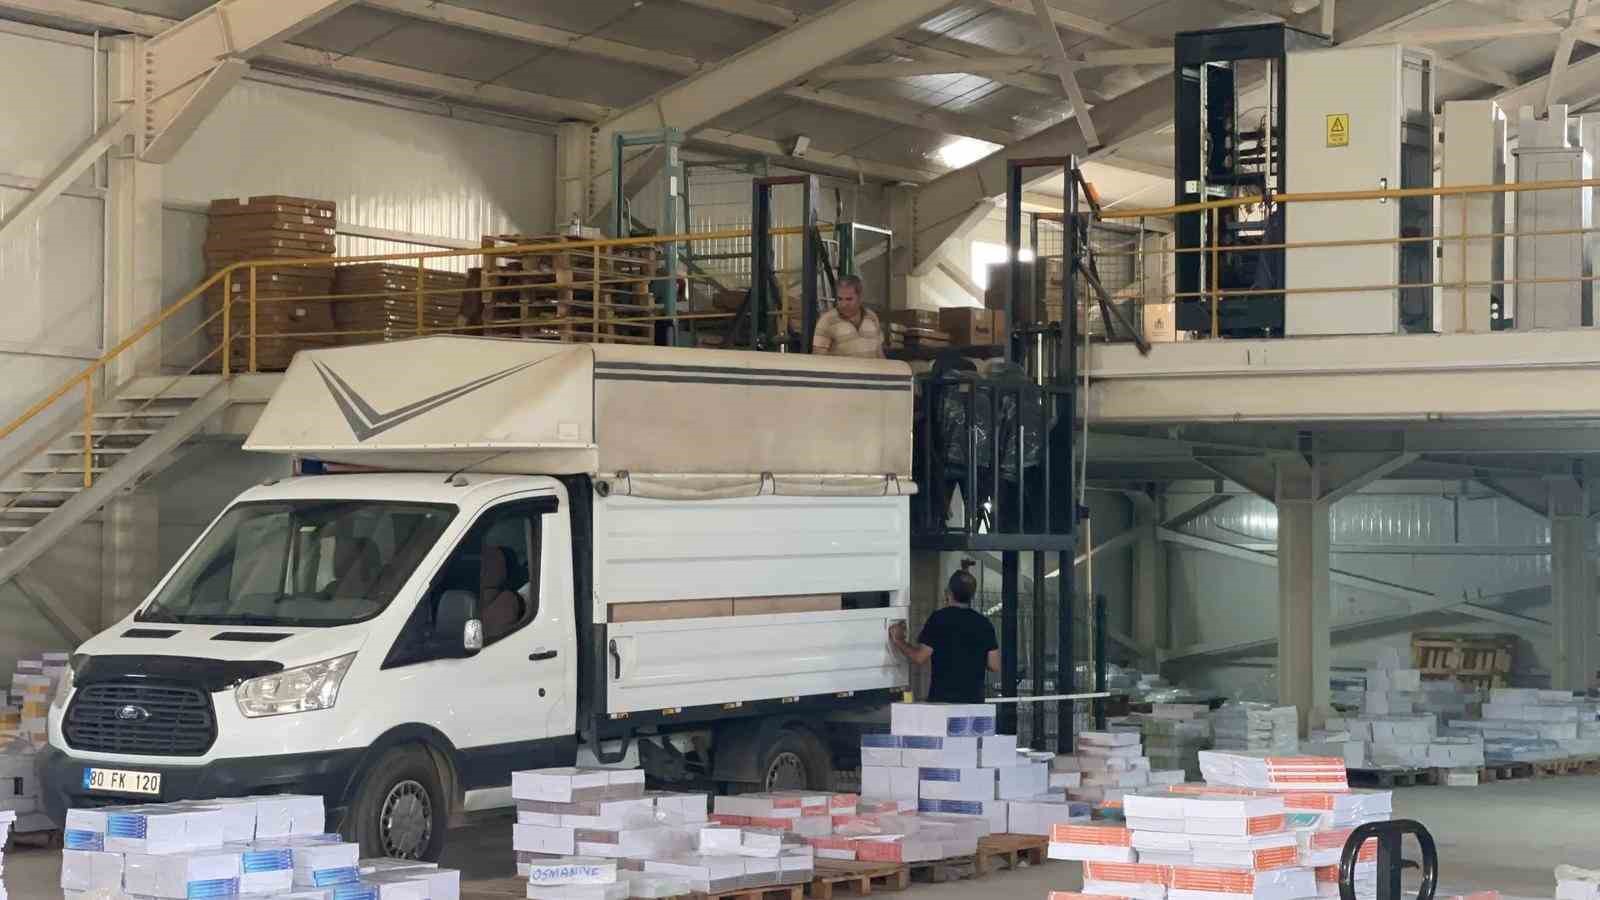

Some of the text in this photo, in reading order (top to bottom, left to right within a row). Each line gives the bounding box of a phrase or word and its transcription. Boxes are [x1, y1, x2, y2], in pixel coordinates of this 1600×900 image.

[89, 771, 158, 791] 80 FK 120
